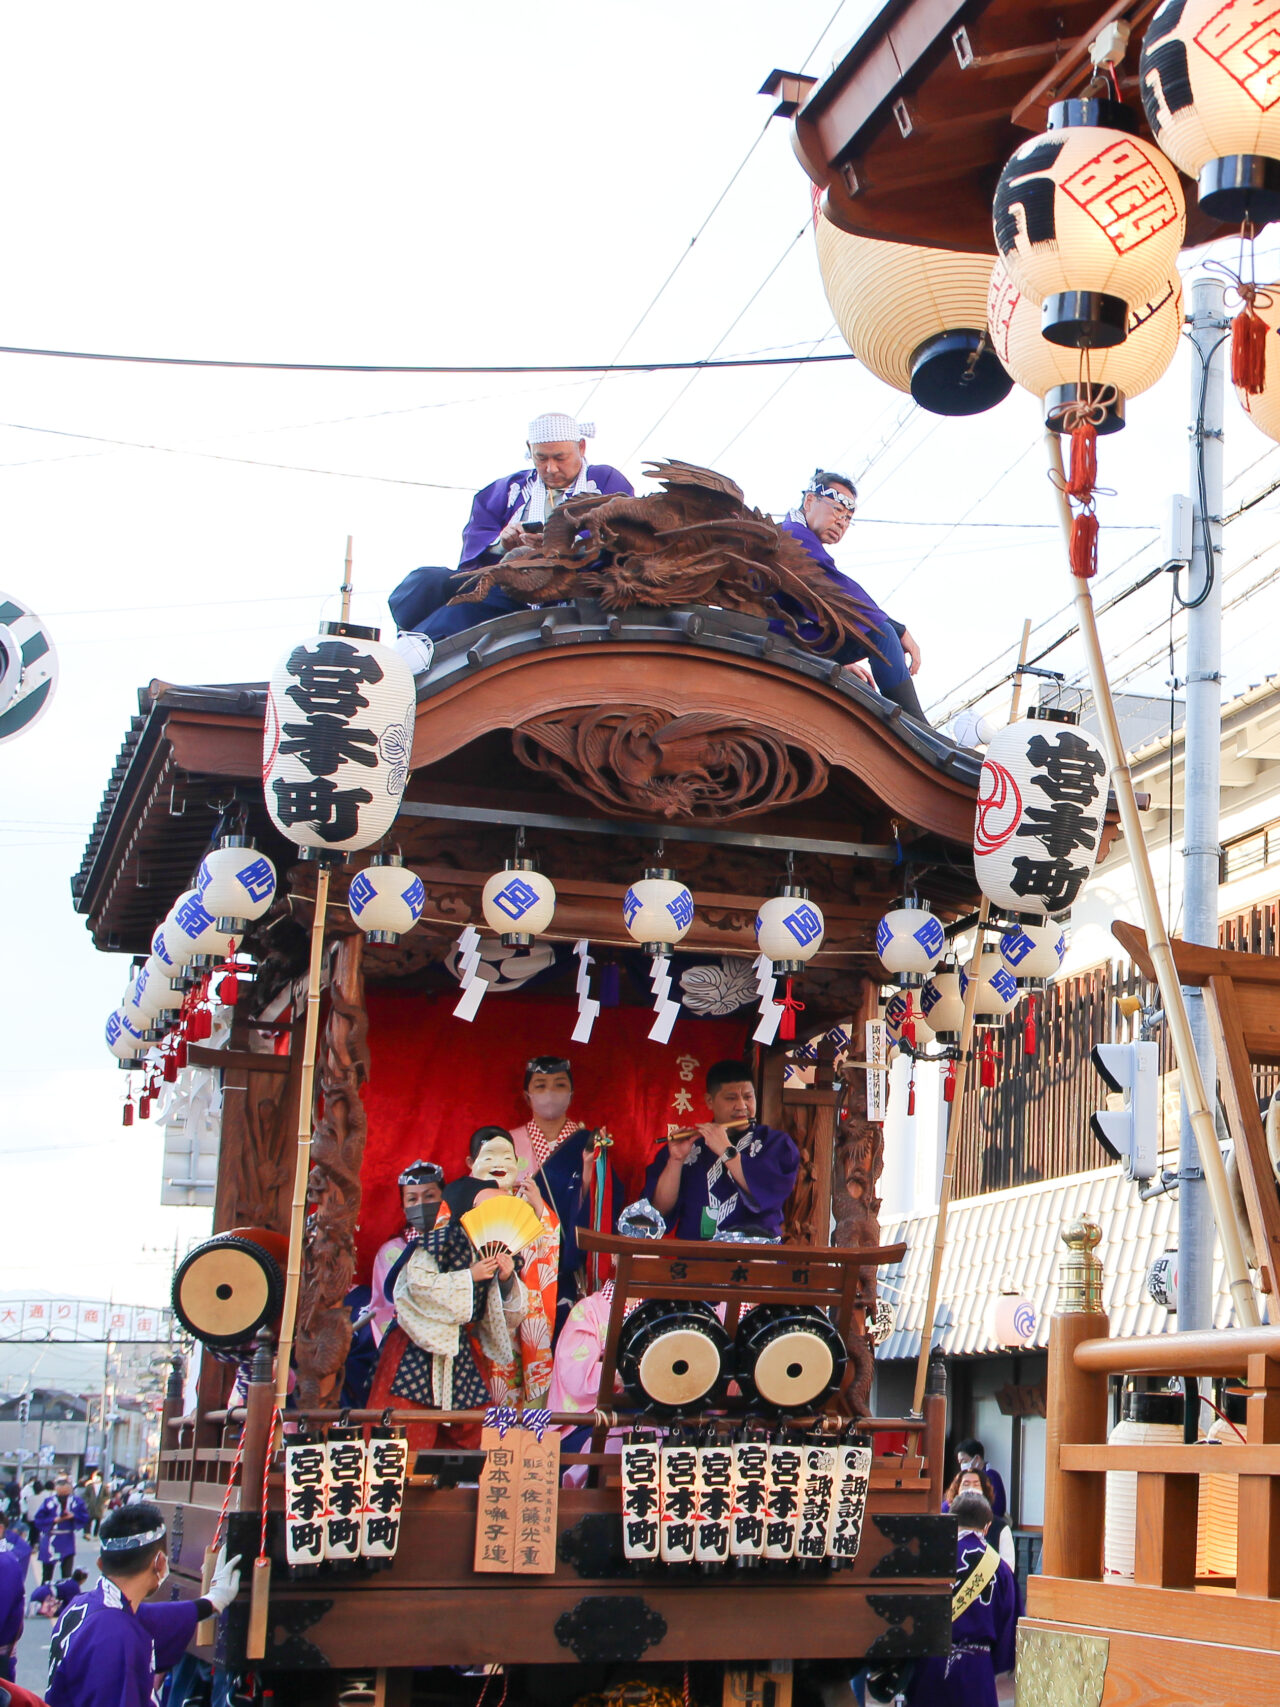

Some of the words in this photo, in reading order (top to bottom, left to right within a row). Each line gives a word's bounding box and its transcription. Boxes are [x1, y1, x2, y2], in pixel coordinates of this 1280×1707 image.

[272, 641, 384, 843] 宮本町
[1010, 731, 1106, 912] 宮本町
[1, 1304, 152, 1332] 大通り商店街
[290, 1448, 324, 1557] 宮本町
[327, 1444, 363, 1553] 宮本町
[367, 1443, 405, 1551] 宮本町
[625, 1448, 658, 1553] 宮本町
[665, 1452, 697, 1555] 宮本町
[699, 1452, 732, 1556] 宮本町
[734, 1446, 767, 1548] 宮本町
[767, 1451, 801, 1553] 宮本町
[798, 1473, 834, 1556] 諏訪八幡
[832, 1474, 868, 1556] 諏訪八幡
